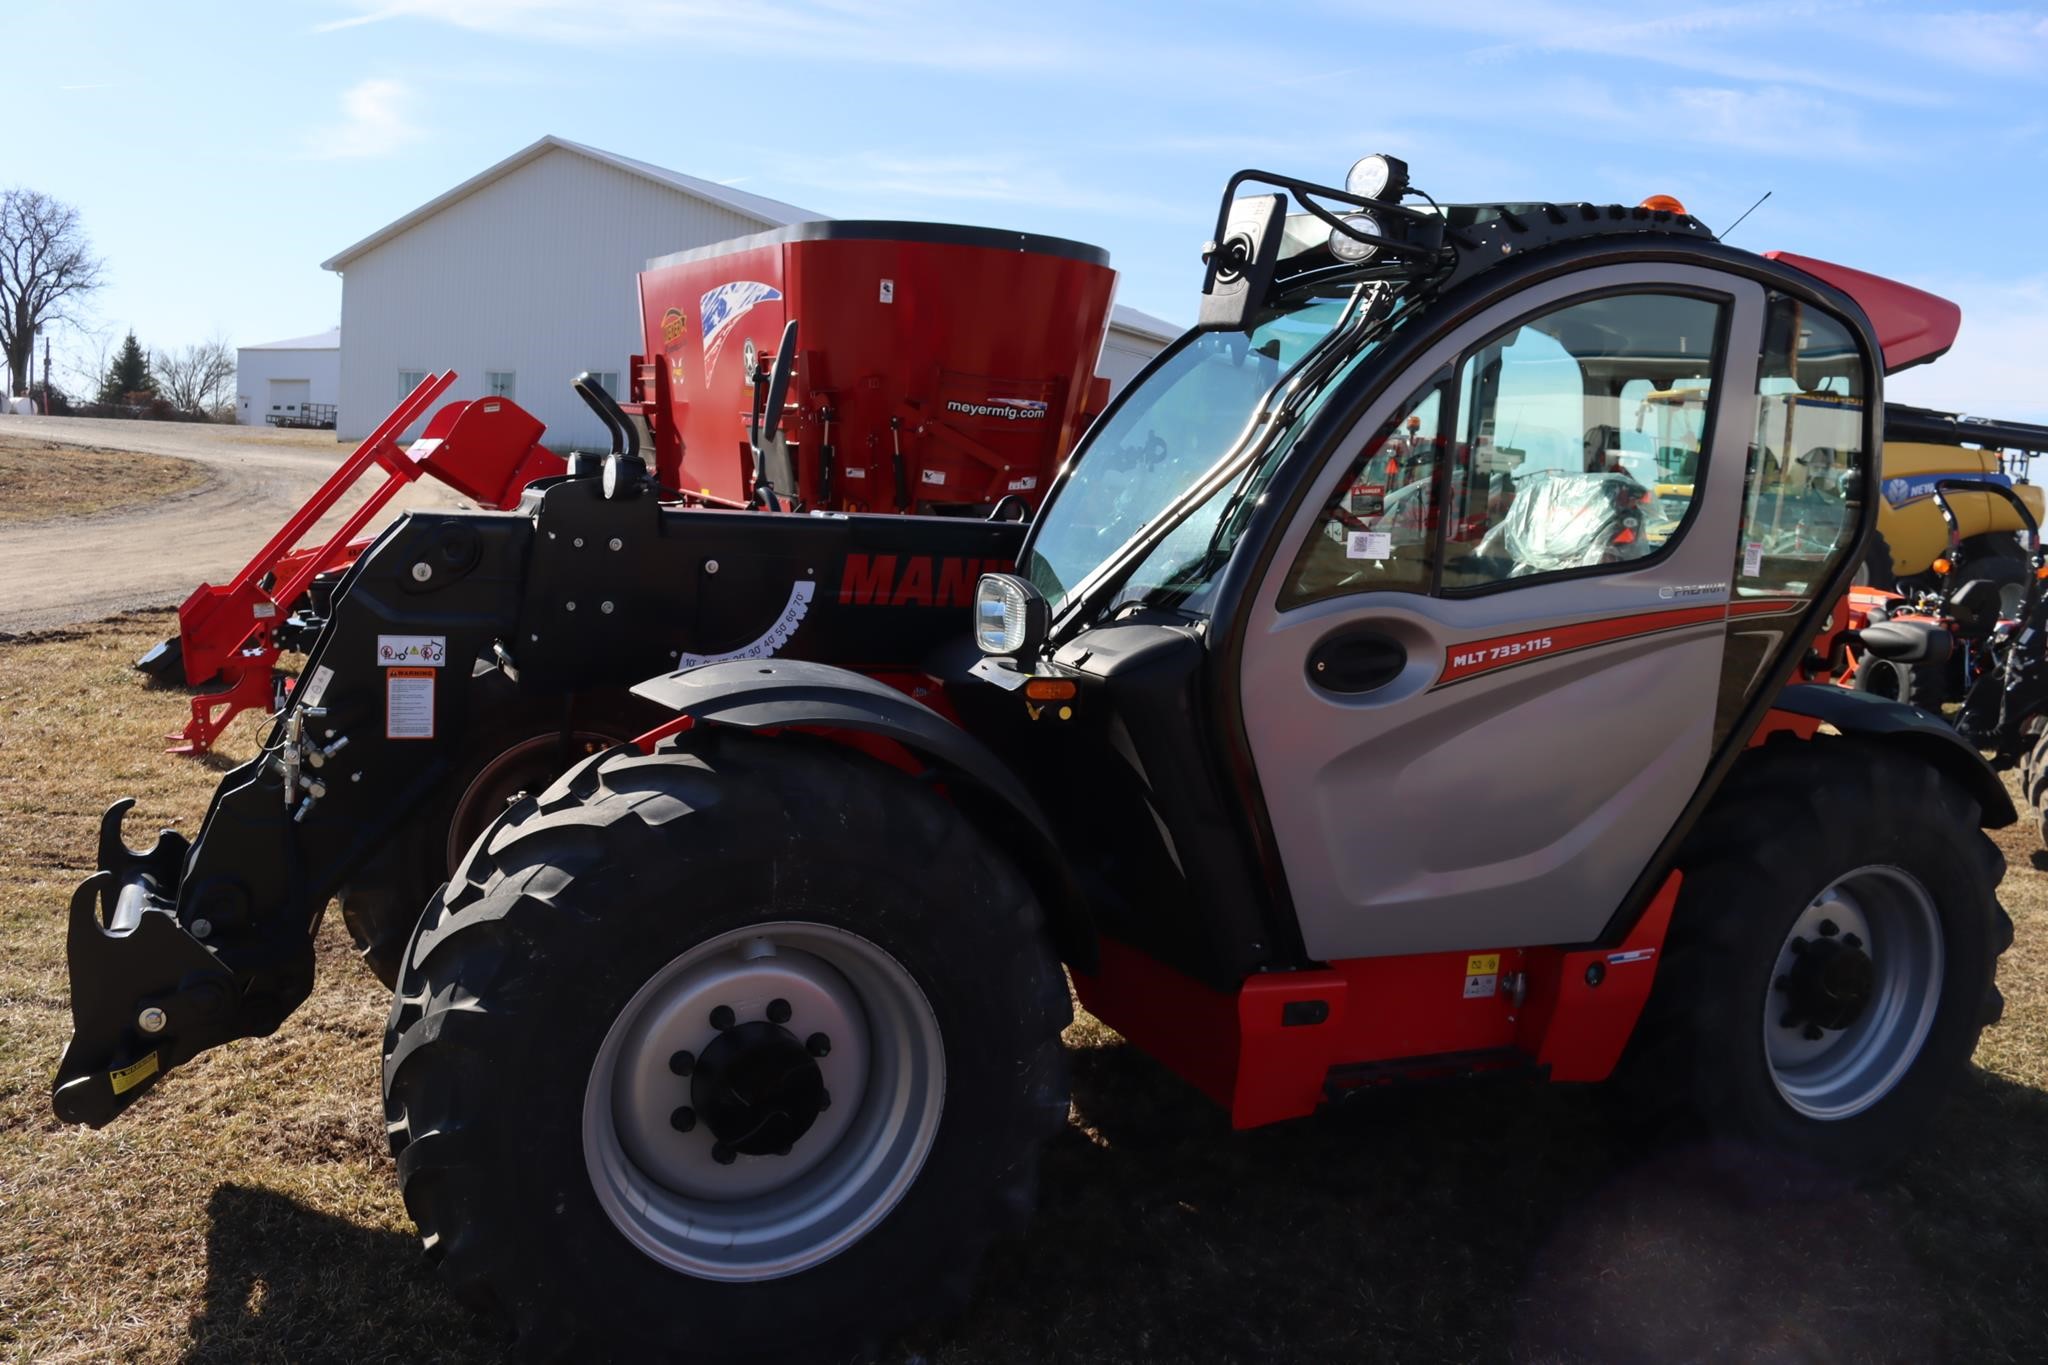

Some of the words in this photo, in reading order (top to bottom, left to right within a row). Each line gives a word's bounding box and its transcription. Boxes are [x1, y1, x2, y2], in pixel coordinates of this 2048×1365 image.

[947, 399, 1045, 421] meyermfg.com
[1673, 582, 1727, 598] PREMIUM
[1454, 651, 1487, 667] MLT
[1490, 637, 1552, 659] 733-115
